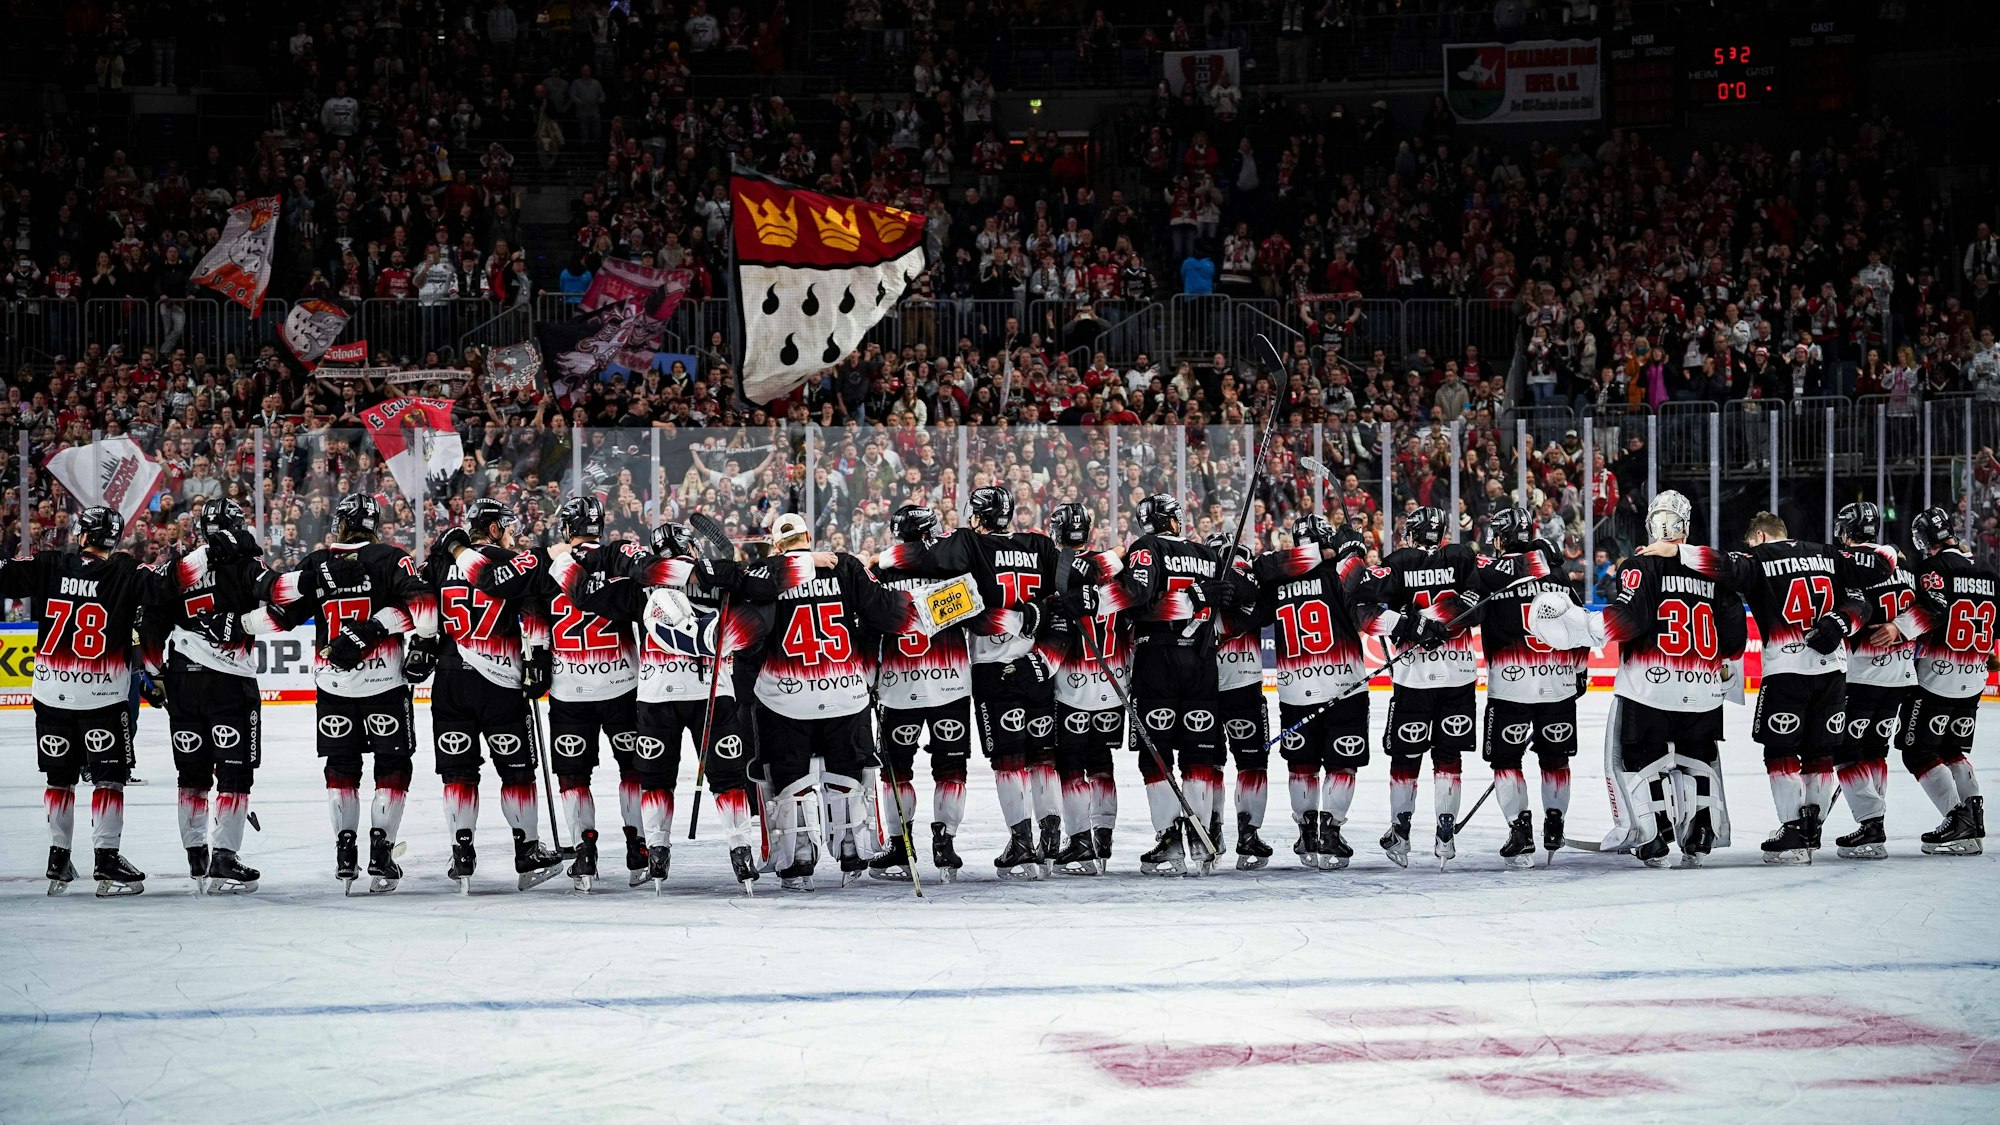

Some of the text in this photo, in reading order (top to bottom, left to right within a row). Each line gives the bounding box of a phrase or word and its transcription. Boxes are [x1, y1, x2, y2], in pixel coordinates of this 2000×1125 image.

[1632, 34, 1655, 45] HEIM
[1688, 66, 1776, 80] HEIM GAST
[995, 550, 1038, 569] AUBRY
[1130, 549, 1152, 568] 76
[1762, 554, 1836, 577] VITTASMÄKI
[60, 577, 99, 598] BOKK
[1404, 567, 1456, 588] NIEDENZ
[1620, 568, 1642, 590] 30
[1661, 575, 1716, 599] JUVONEN
[1919, 571, 1945, 592] 63
[1277, 578, 1322, 601] STORM
[932, 591, 962, 610] Radio
[939, 602, 963, 620] Köln
[441, 586, 506, 641] 57
[551, 592, 619, 651] 22
[40, 598, 108, 659] 78
[781, 601, 852, 666] 45
[1275, 599, 1334, 659] 19
[1657, 598, 1718, 660] 30
[1946, 598, 1996, 653] 63
[567, 657, 630, 675] TOYOTA
[1419, 650, 1474, 663] TOYOTA
[54, 670, 113, 684] TOYOTA
[901, 668, 960, 682] TOYOTA
[1295, 663, 1353, 680] TOYOTA
[806, 673, 863, 692] TOYOTA
[980, 702, 993, 738] TOYOTA
[1907, 698, 1923, 730] TOYOTA
[123, 727, 133, 765] TOYOTA
[250, 726, 258, 762] TOYOTA
